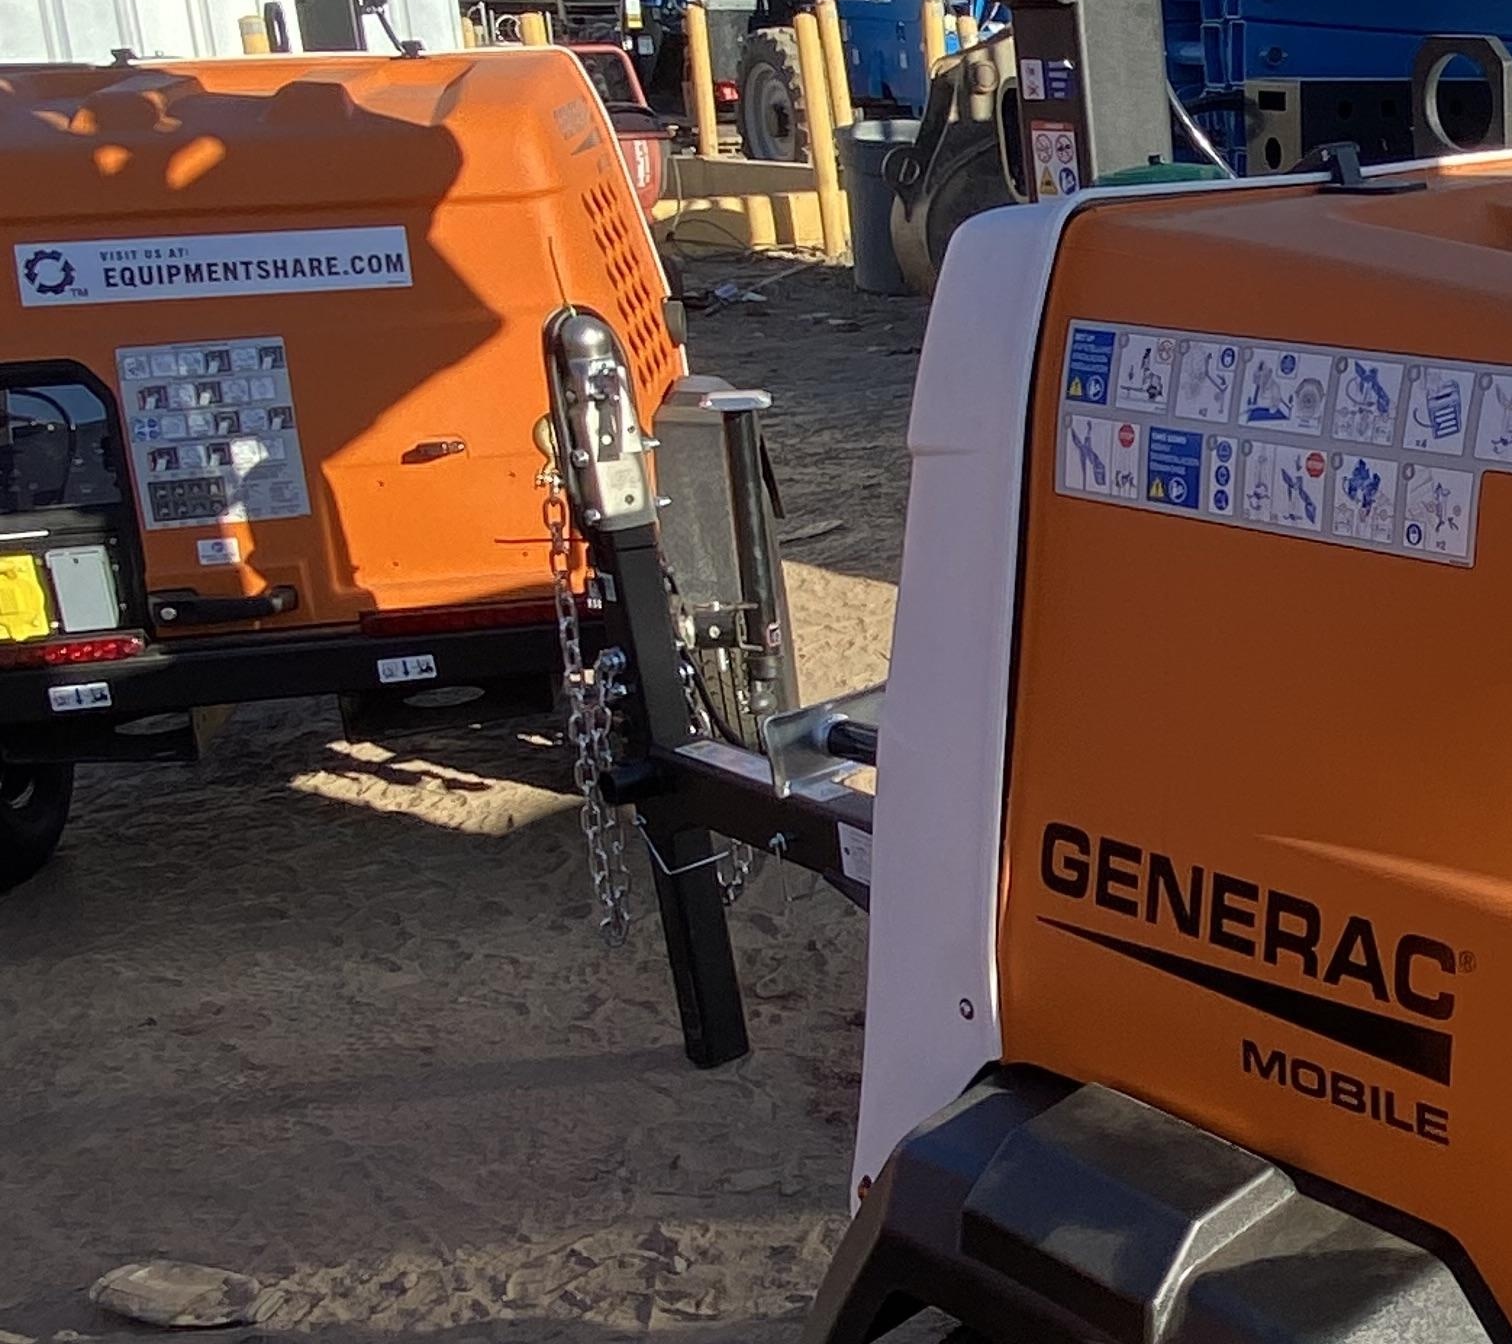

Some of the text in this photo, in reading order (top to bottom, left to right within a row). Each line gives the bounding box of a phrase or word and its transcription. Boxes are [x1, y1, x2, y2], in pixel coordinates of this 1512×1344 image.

[100, 249, 138, 262] VISIT
[144, 248, 162, 260] US
[103, 253, 405, 288] EQUIPMENTSHARE.COM
[1242, 1039, 1450, 1146] MOBILE
